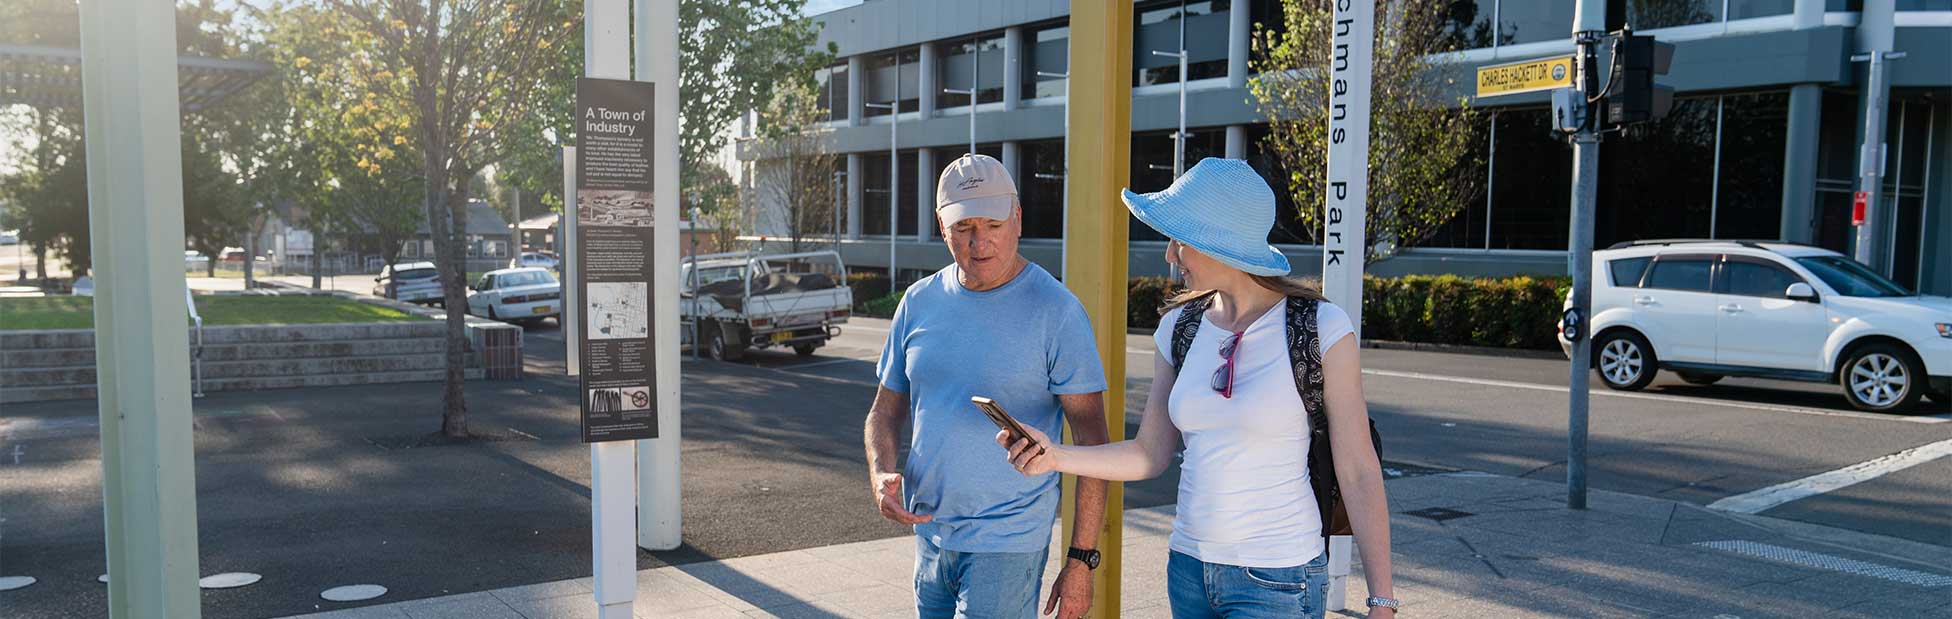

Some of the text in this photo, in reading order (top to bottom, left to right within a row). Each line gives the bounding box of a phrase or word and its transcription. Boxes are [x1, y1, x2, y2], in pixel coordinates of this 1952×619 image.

[1481, 68, 1509, 87] CHARLES
[1510, 64, 1538, 83] HACKETT
[1538, 63, 1547, 80] DR
[585, 106, 646, 122] A Town of
[585, 120, 636, 136] Industry
[1328, 181, 1347, 266] Park
